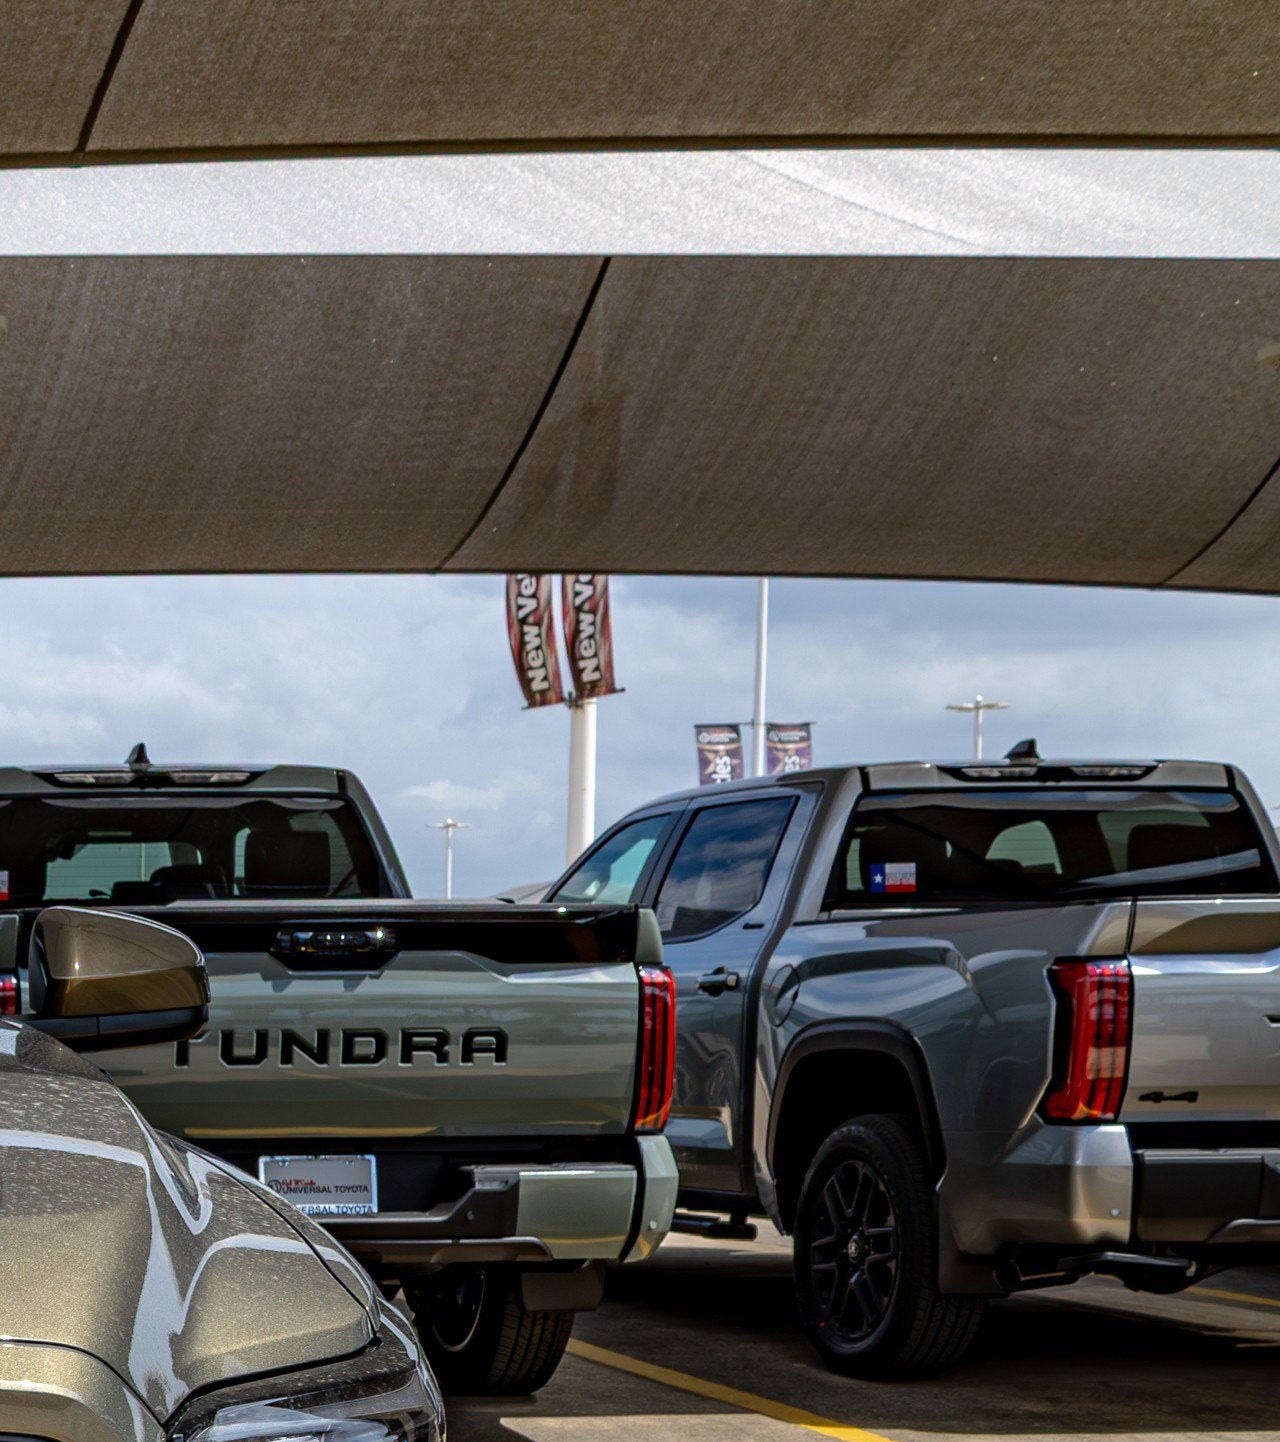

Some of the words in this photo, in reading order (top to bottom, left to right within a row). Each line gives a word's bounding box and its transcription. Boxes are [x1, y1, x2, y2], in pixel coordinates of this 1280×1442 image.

[523, 625, 550, 692] New
[578, 611, 601, 683] New
[282, 1185, 333, 1194] UNIVERSAL
[335, 1185, 369, 1194] TOYOTA
[301, 1206, 334, 1215] ERSAL
[336, 1206, 374, 1215] TOYOTA
